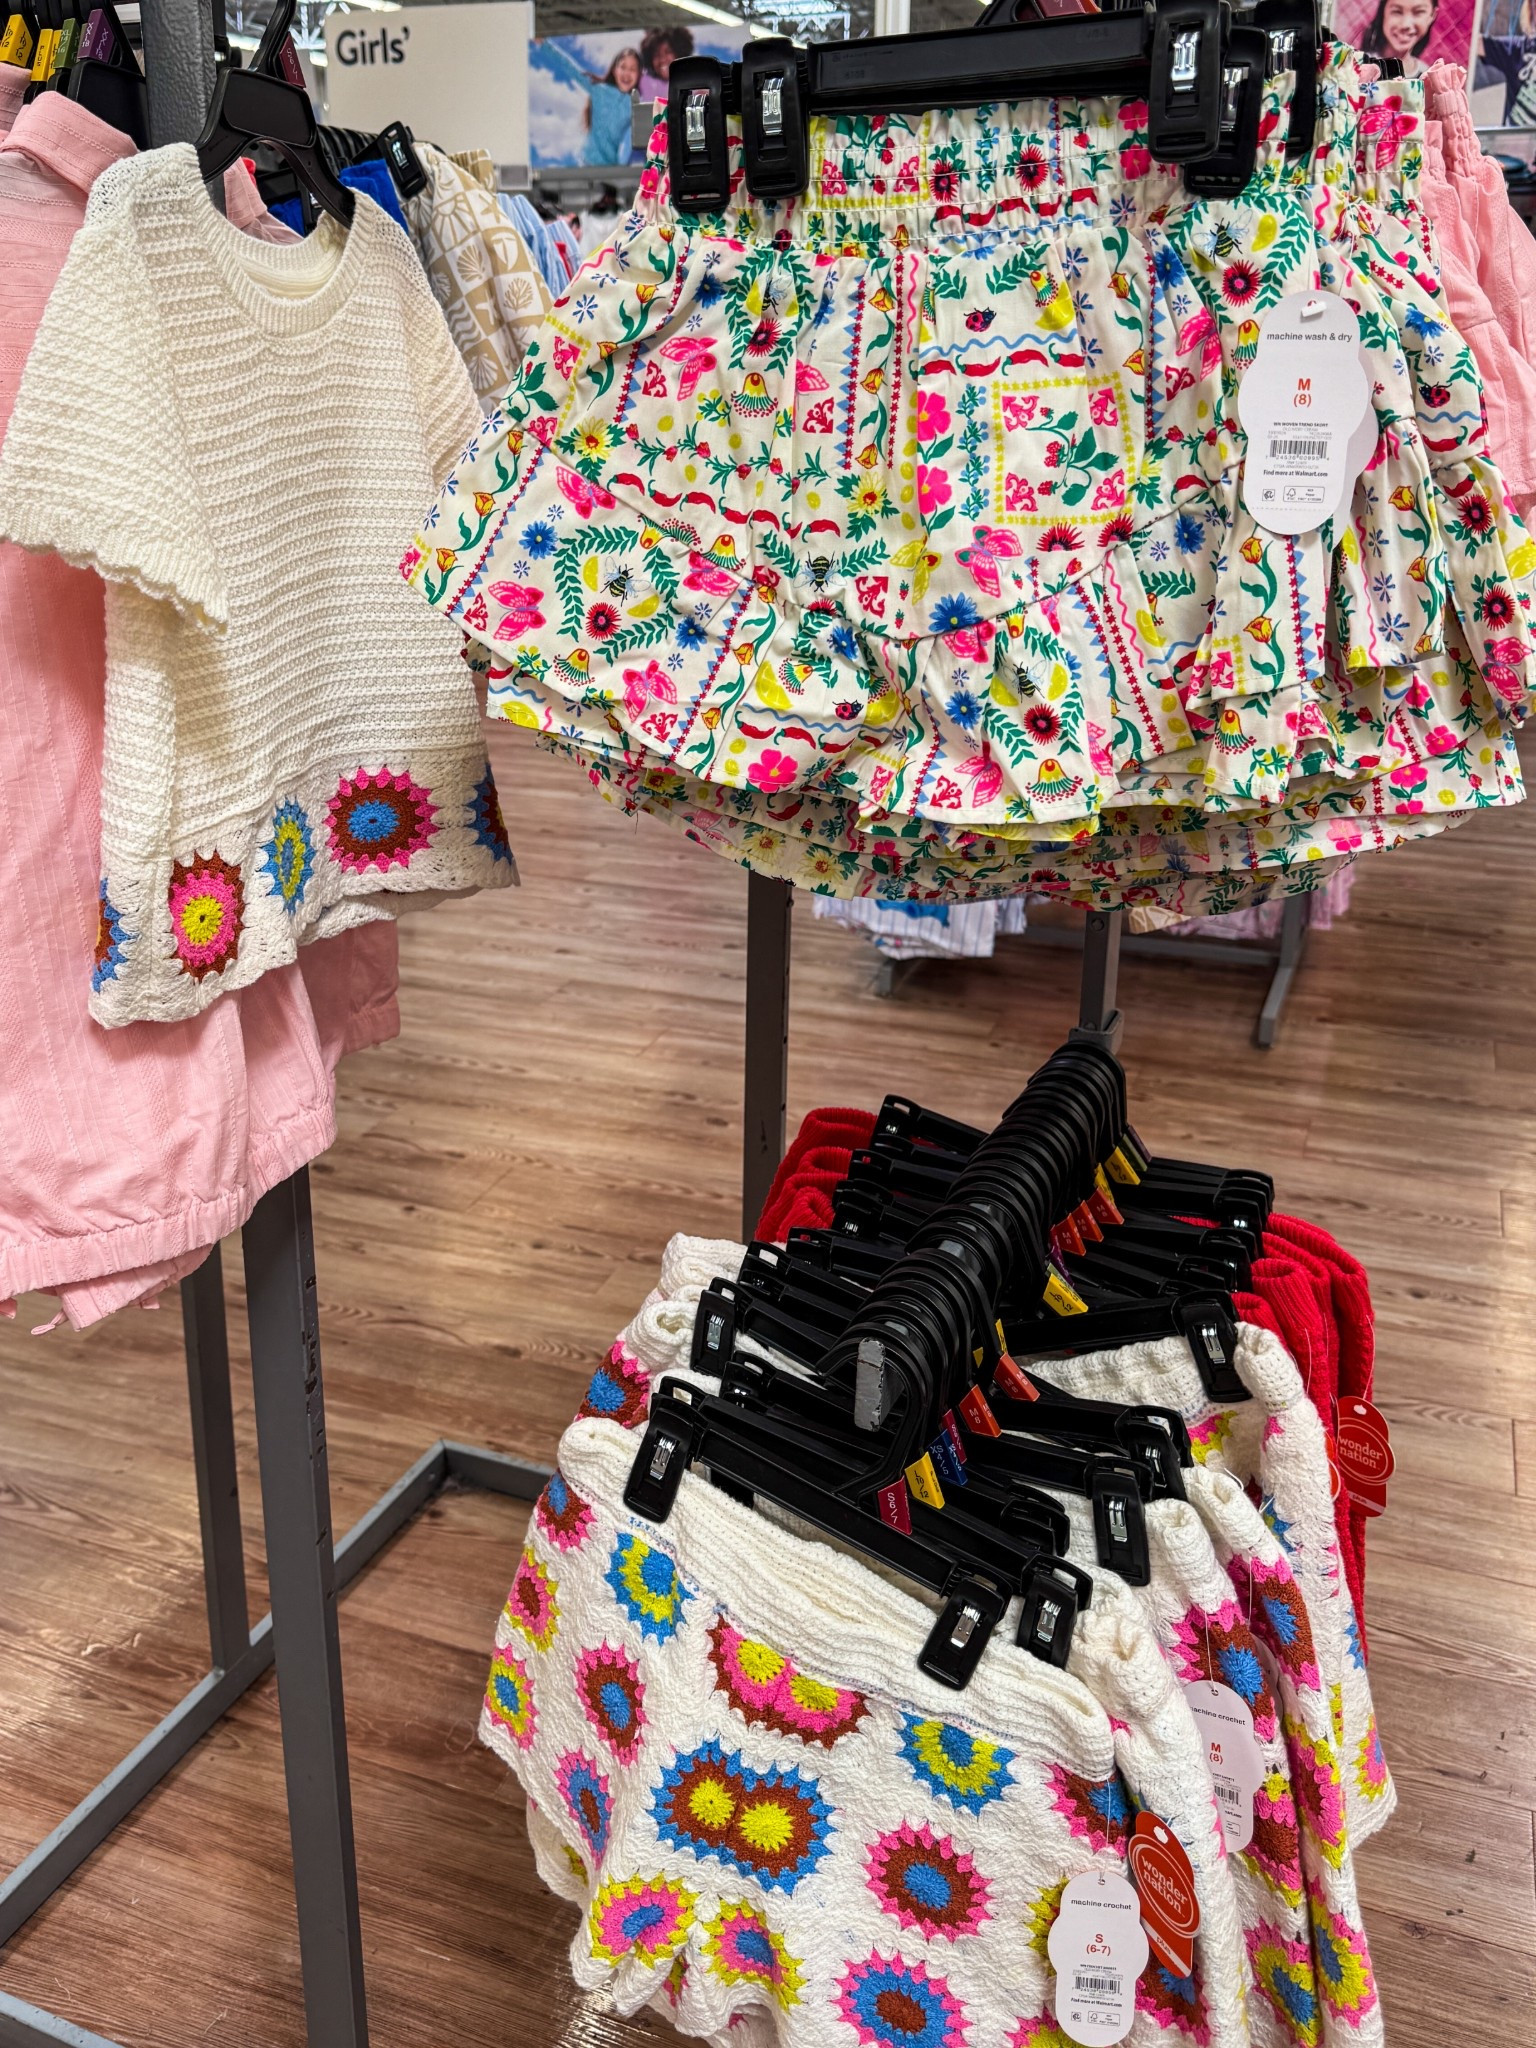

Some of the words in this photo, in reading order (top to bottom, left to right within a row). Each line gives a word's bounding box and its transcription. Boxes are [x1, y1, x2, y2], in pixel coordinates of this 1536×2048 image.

[1266, 332, 1302, 340] machine
[1304, 332, 1328, 341] wash
[1330, 333, 1336, 341] &
[1338, 333, 1352, 342] dry
[1298, 378, 1311, 390] M
[1293, 394, 1312, 408] (8)
[969, 1408, 979, 1417] M
[930, 1445, 944, 1454] XS
[1339, 1436, 1383, 1461] wonder
[1339, 1446, 1377, 1469] nation
[888, 1492, 895, 1502] S
[1217, 1714, 1246, 1725] crochet
[1211, 1742, 1221, 1753] M
[1209, 1753, 1224, 1765] (8)
[1141, 1855, 1188, 1905] wonder
[1143, 1869, 1182, 1914] nation
[1071, 1899, 1102, 1908] machine
[1103, 1902, 1132, 1910] crochet
[1095, 1934, 1103, 1944] S
[1086, 1945, 1111, 1956] (6-7)
[1156, 1936, 1172, 1955] plus
